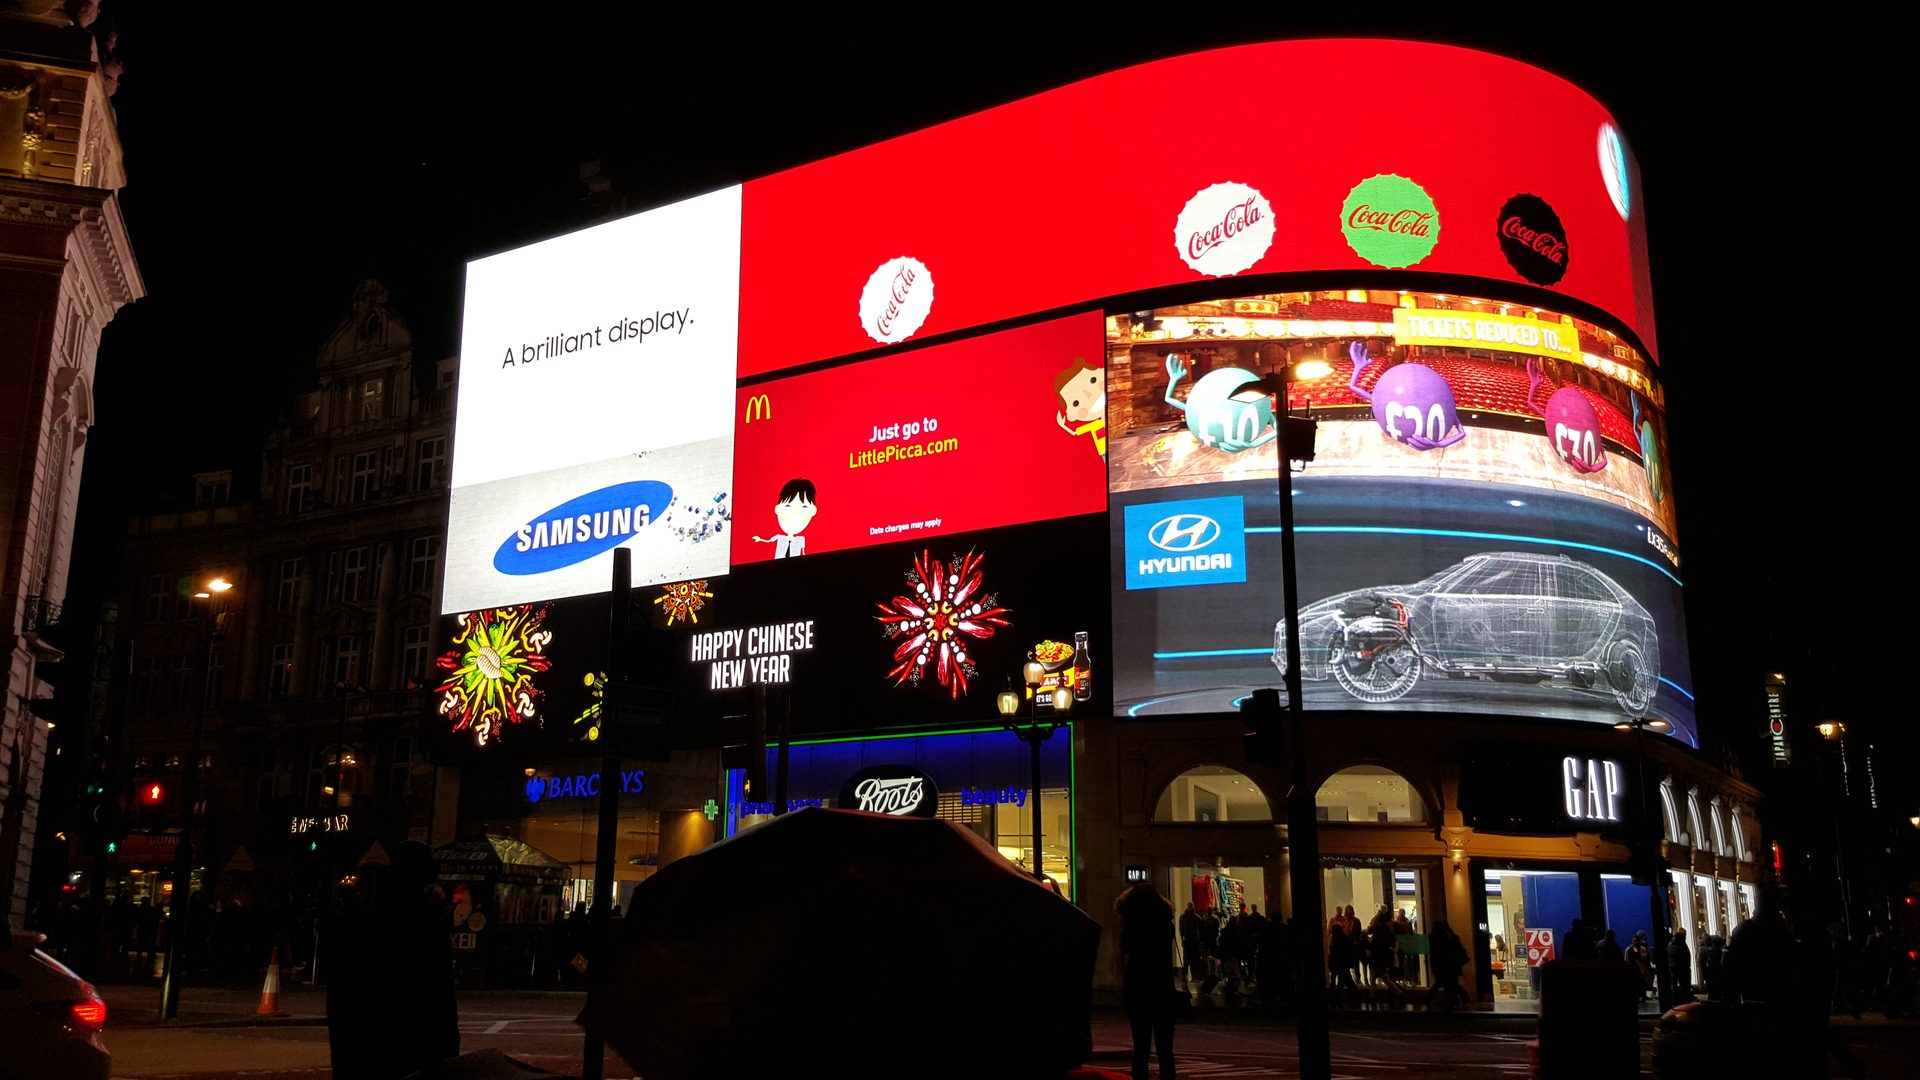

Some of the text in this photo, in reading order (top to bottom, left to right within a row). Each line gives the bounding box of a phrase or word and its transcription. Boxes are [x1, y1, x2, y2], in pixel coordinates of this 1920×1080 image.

[502, 307, 695, 370] A brilliant display.
[1408, 315, 1572, 354] TICKETS REDUCED TO...
[868, 417, 938, 443] Just go to
[849, 437, 958, 469] LittlePicca.com
[516, 504, 650, 552] SAMSUNG
[870, 517, 942, 535] Data charges may apply
[1139, 553, 1232, 575] HYUNDAI
[691, 620, 814, 662] HAPPY CHINESE
[711, 654, 791, 690] NEW YEAR
[549, 770, 645, 798] BARCYS
[855, 775, 924, 815] Boots
[961, 785, 1027, 808] beauty
[1562, 756, 1619, 820] GAP
[1525, 930, 1553, 946] 70
